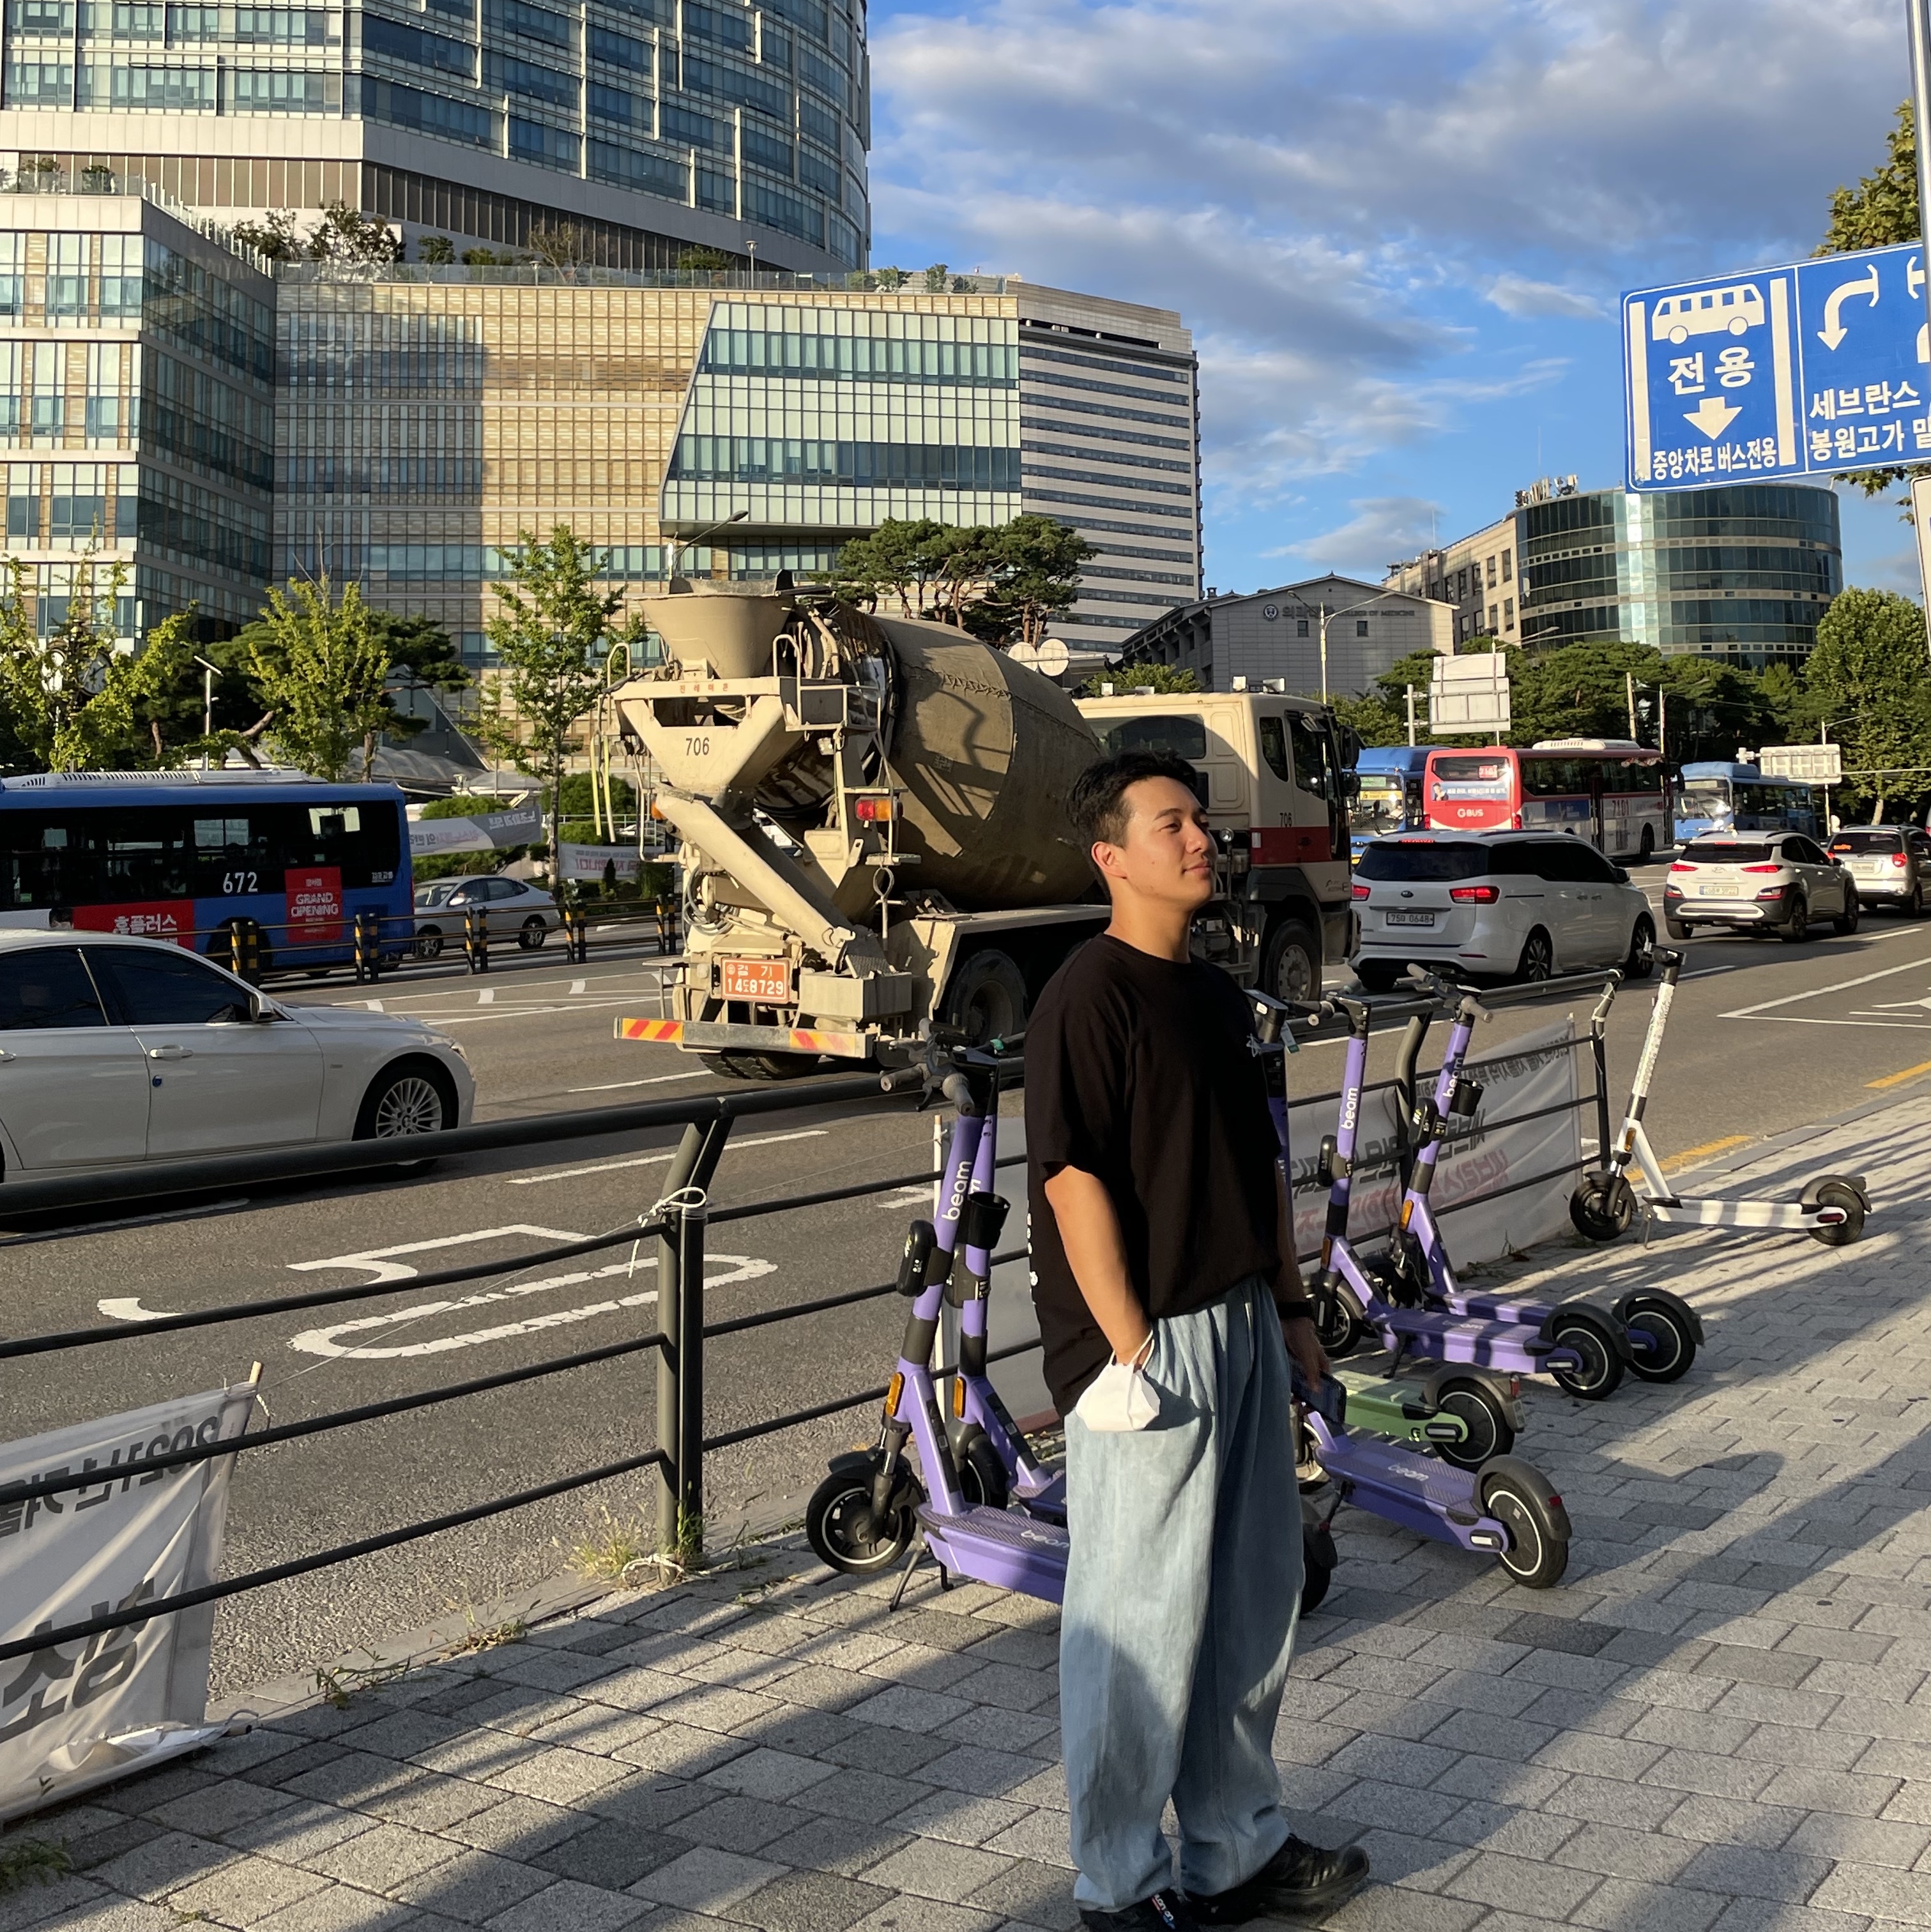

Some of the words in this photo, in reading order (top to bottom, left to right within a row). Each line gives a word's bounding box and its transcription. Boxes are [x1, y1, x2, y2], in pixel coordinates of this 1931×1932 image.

[1668, 346, 1755, 396] 전용
[1809, 381, 1921, 421] 세브란스
[1652, 446, 1715, 481] 중앙차로
[1718, 436, 1778, 473] 버스전용
[1810, 419, 1905, 462] 봉원고가
[685, 736, 710, 756] 706
[1279, 812, 1293, 828] 706
[222, 871, 258, 894] 672
[296, 892, 333, 905] GRAND
[113, 913, 178, 935] 홈플러스
[291, 902, 339, 918] OPENING
[1442, 1056, 1463, 1098] beam
[1341, 1087, 1359, 1129] beam
[941, 1160, 972, 1221] beam
